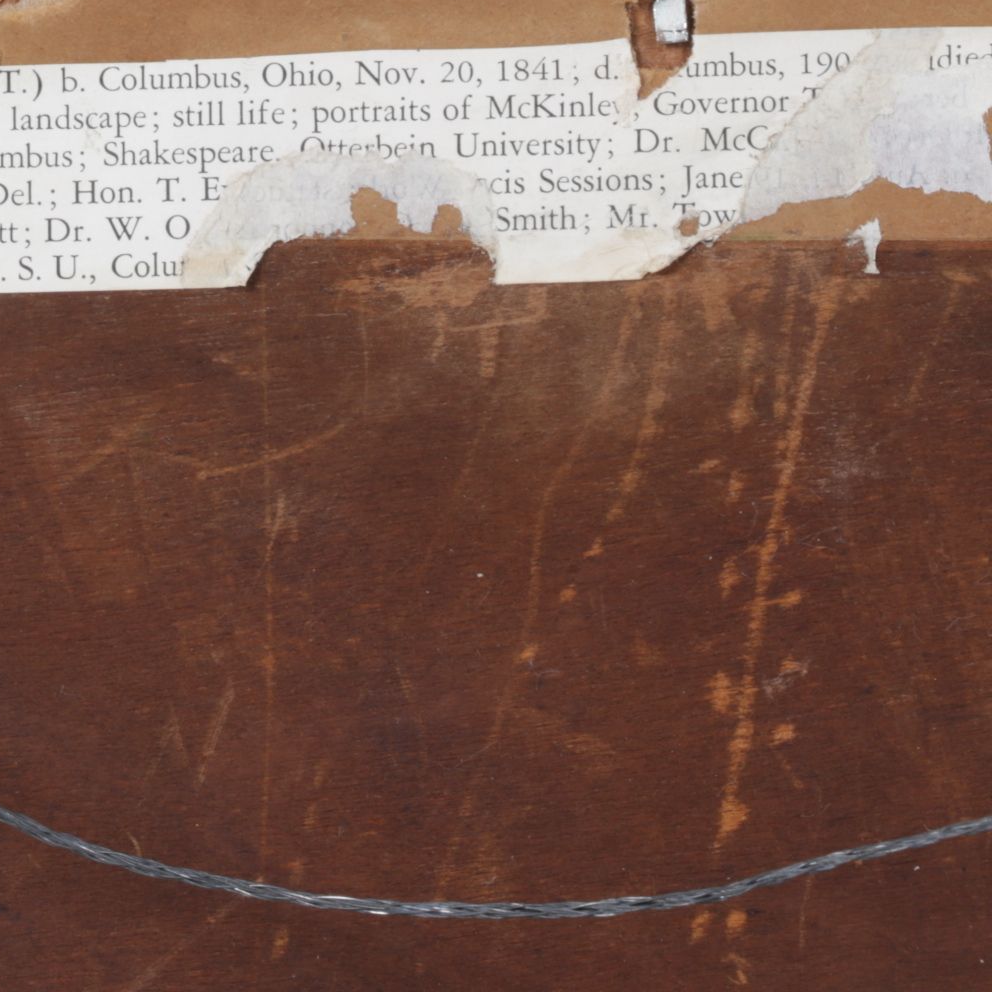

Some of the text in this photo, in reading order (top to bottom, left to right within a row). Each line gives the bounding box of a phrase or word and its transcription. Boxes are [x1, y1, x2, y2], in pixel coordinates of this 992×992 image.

[60, 66, 85, 93] b.
[98, 65, 250, 92] Columbus,
[261, 61, 342, 91] Ohio,
[355, 60, 425, 86] Nov.
[441, 61, 482, 85] 20,
[498, 59, 579, 83] 1841;
[594, 54, 619, 80] d.
[678, 51, 785, 80] umbus,
[802, 52, 851, 74] 190
[11, 104, 159, 138] landscape;
[173, 100, 225, 128] still
[238, 98, 298, 130] life;
[312, 96, 431, 137] portraits
[442, 94, 473, 121] of
[653, 90, 790, 116] Governor
[454, 130, 614, 164] University;
[634, 128, 680, 153] Dr.
[700, 125, 768, 152] McC
[72, 179, 142, 205] Hon.
[156, 177, 186, 203] T.
[539, 167, 666, 196] Sessions;
[681, 165, 743, 199] Jane
[45, 217, 92, 243] Dr.
[106, 216, 150, 241] W.
[497, 205, 590, 232] Smith;
[609, 204, 658, 229] Mr.
[672, 201, 737, 228] Tow
[18, 255, 41, 281] S.
[53, 254, 96, 285] U.,
[111, 251, 185, 279] Colu
